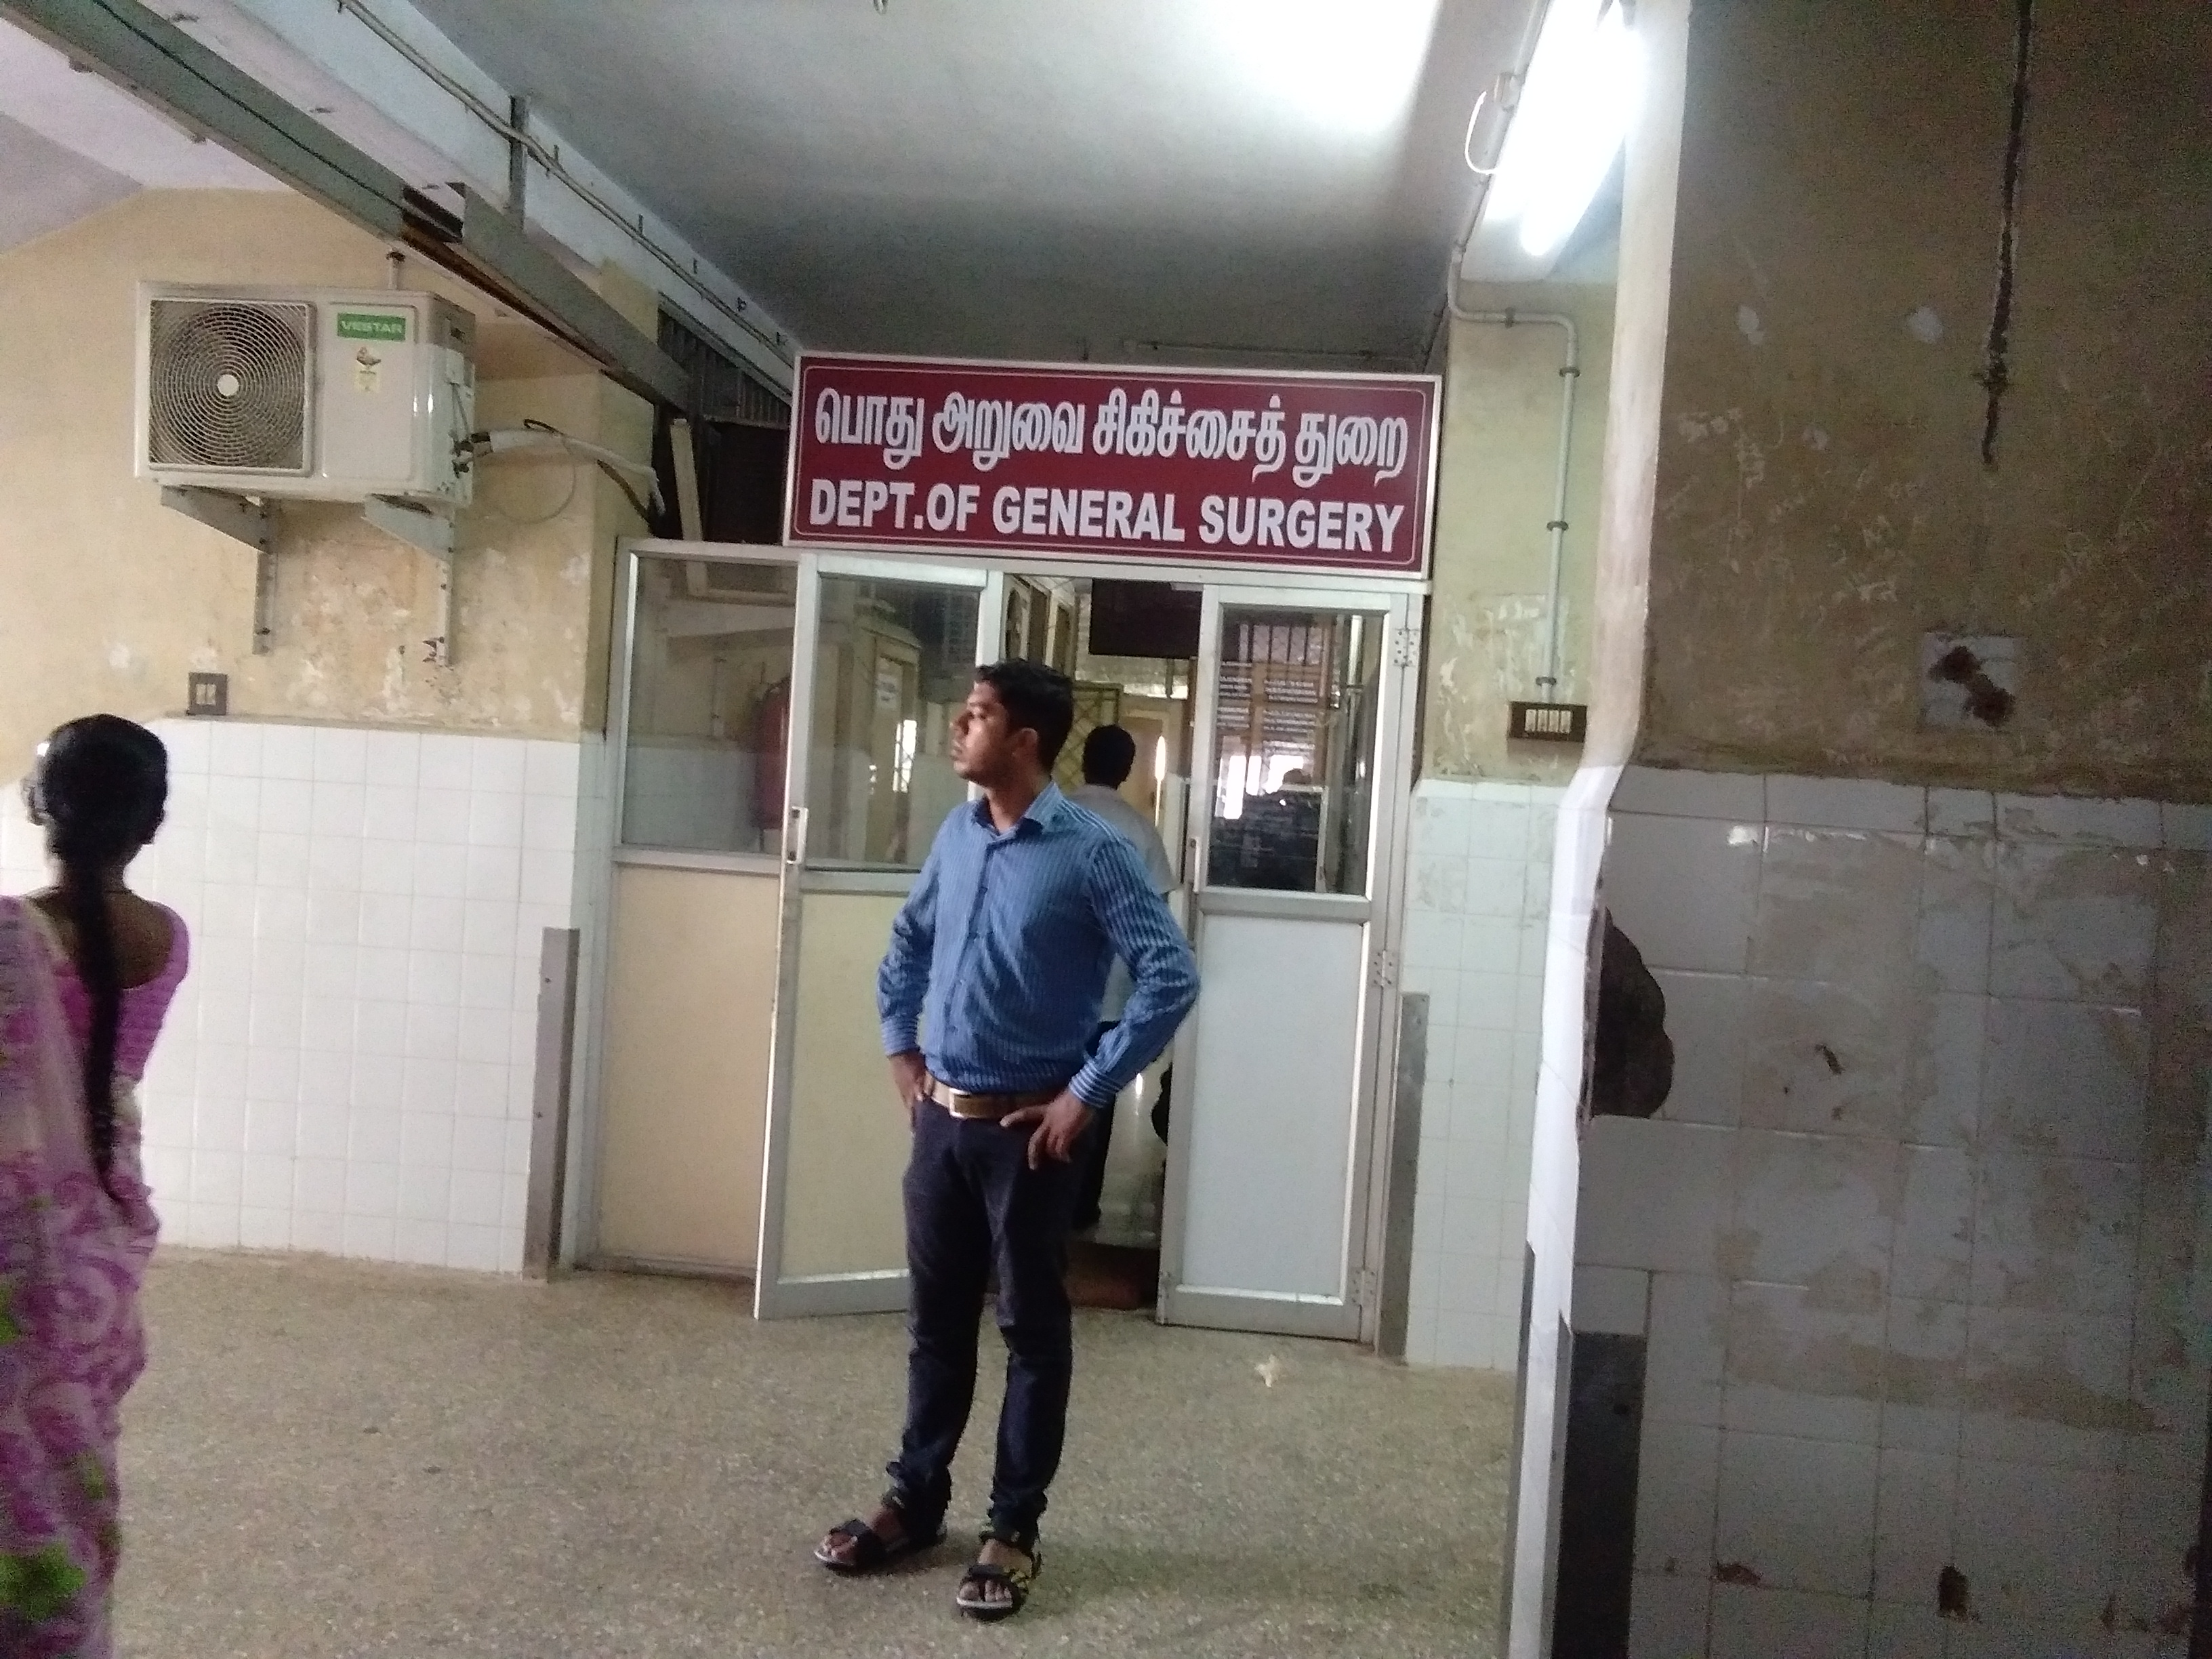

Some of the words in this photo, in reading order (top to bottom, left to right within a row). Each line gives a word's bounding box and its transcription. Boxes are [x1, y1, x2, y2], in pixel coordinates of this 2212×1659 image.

[815, 388, 924, 470] பொது
[932, 391, 1086, 472] அறுவை
[1092, 388, 1287, 482] சிகிச்சைத்
[1292, 411, 1409, 488] துறை
[992, 485, 1186, 542] GENERAL
[1199, 495, 1405, 553] SURGERY
